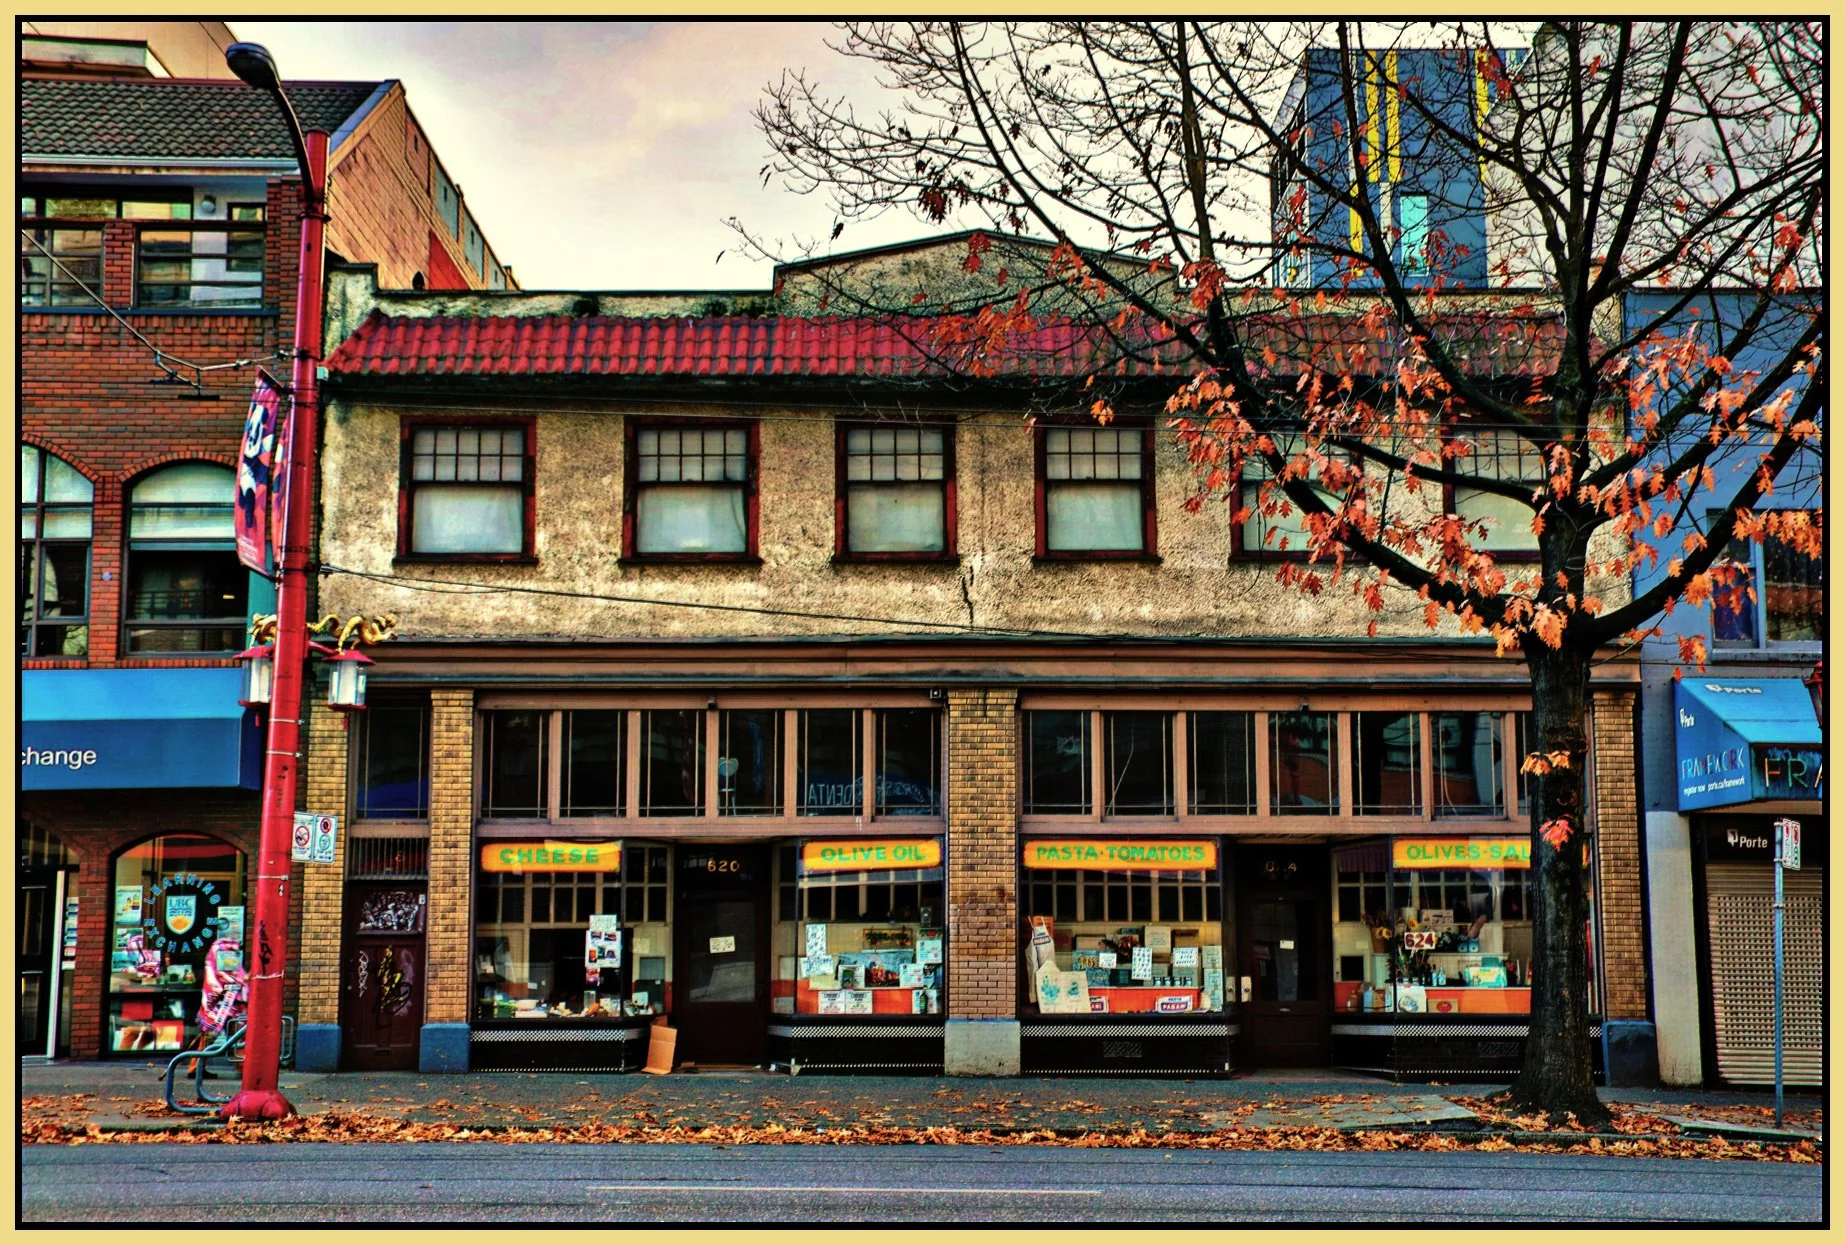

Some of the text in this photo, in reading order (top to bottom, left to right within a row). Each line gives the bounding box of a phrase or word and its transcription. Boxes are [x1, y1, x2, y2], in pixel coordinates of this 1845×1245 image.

[1739, 836, 1768, 848] Porte
[500, 848, 600, 863] CHEESE
[821, 845, 926, 861] OLIVE OIL
[707, 860, 740, 872] 620
[143, 873, 221, 905] LEARNING
[169, 899, 193, 908] UBC
[143, 917, 219, 954] EXCHANGE
[1405, 933, 1435, 949] 624
